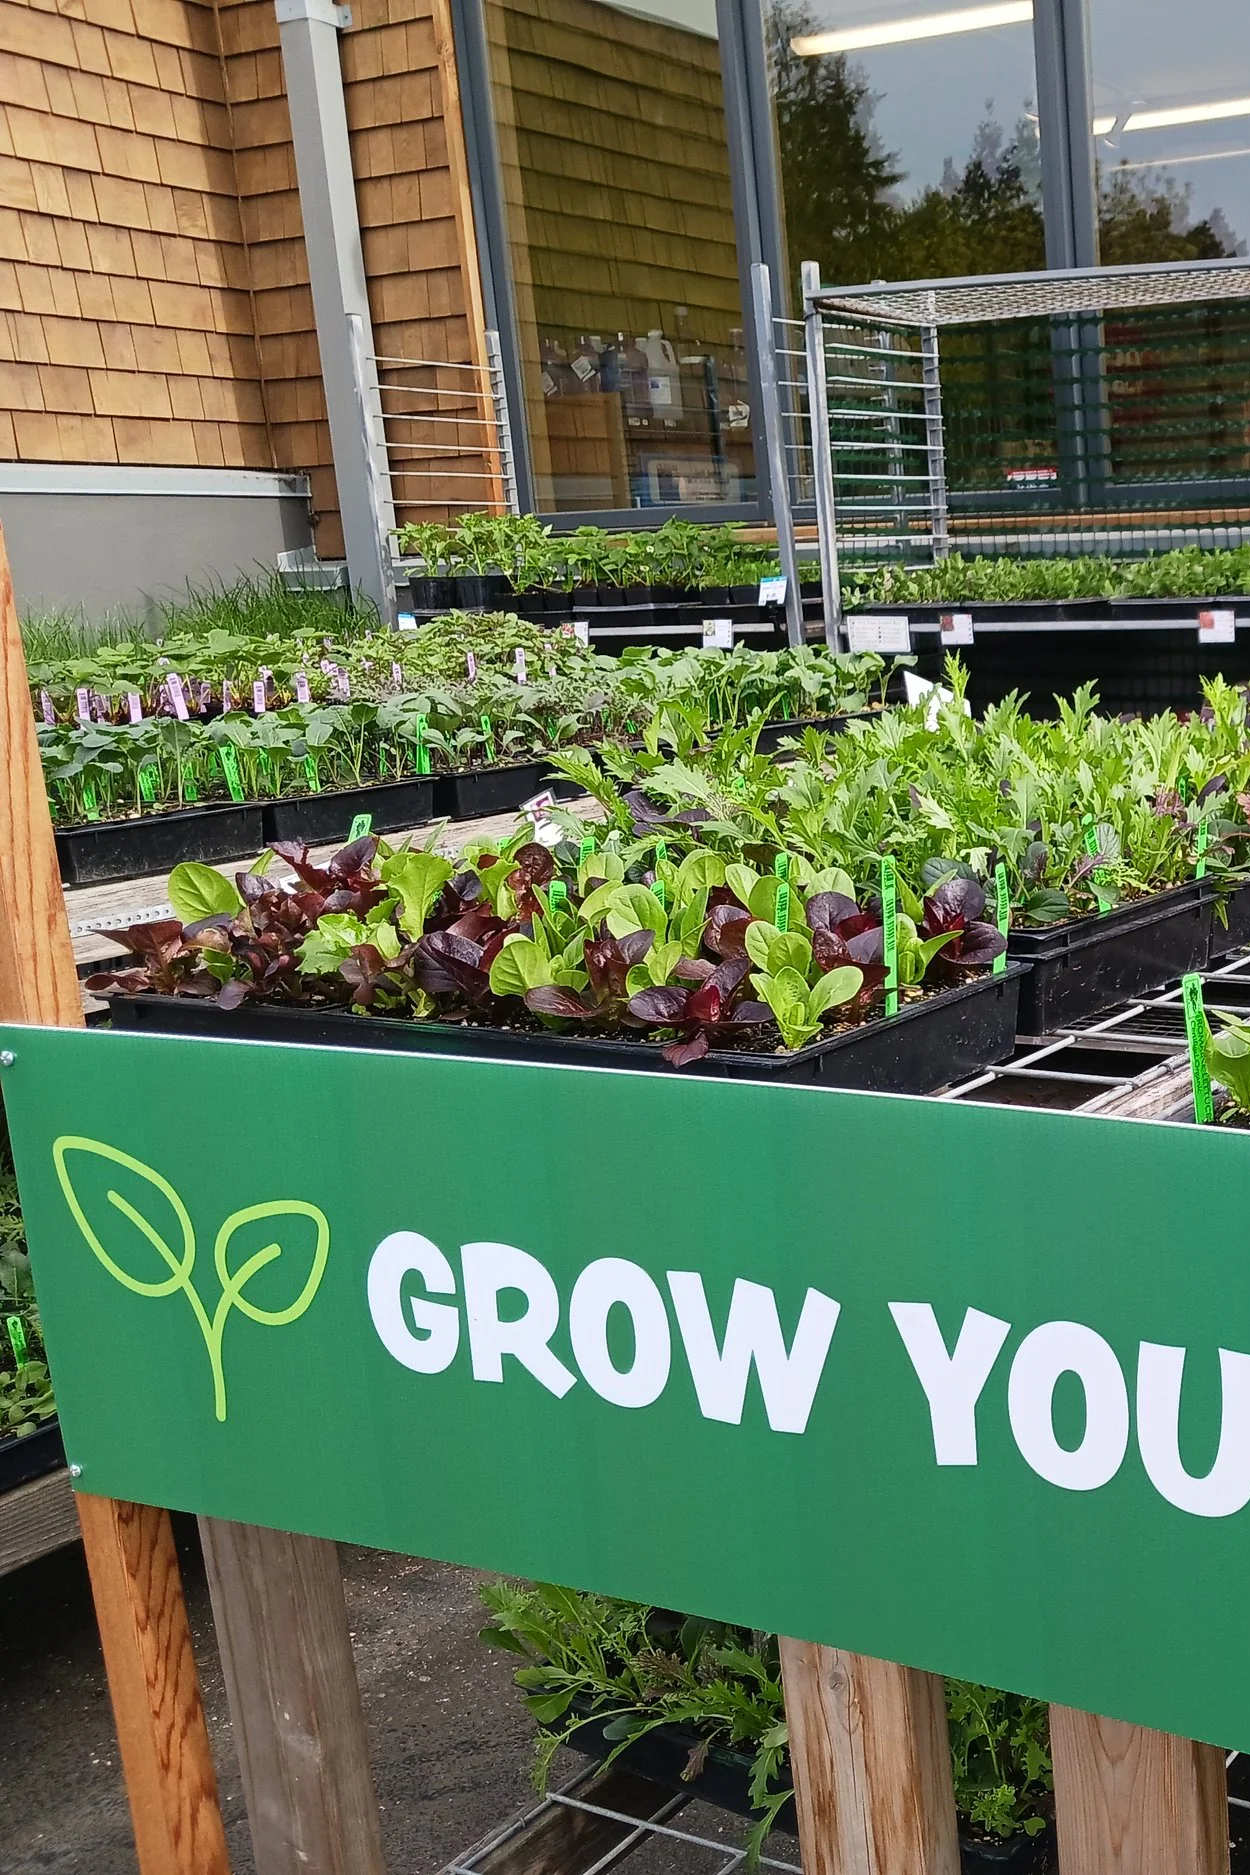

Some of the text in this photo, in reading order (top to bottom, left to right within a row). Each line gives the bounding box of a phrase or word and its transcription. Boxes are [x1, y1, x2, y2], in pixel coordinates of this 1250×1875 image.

[1190, 1020, 1199, 1060] Certified
[1202, 1072, 1212, 1121] LETTUCE
[368, 1231, 840, 1433] GROW
